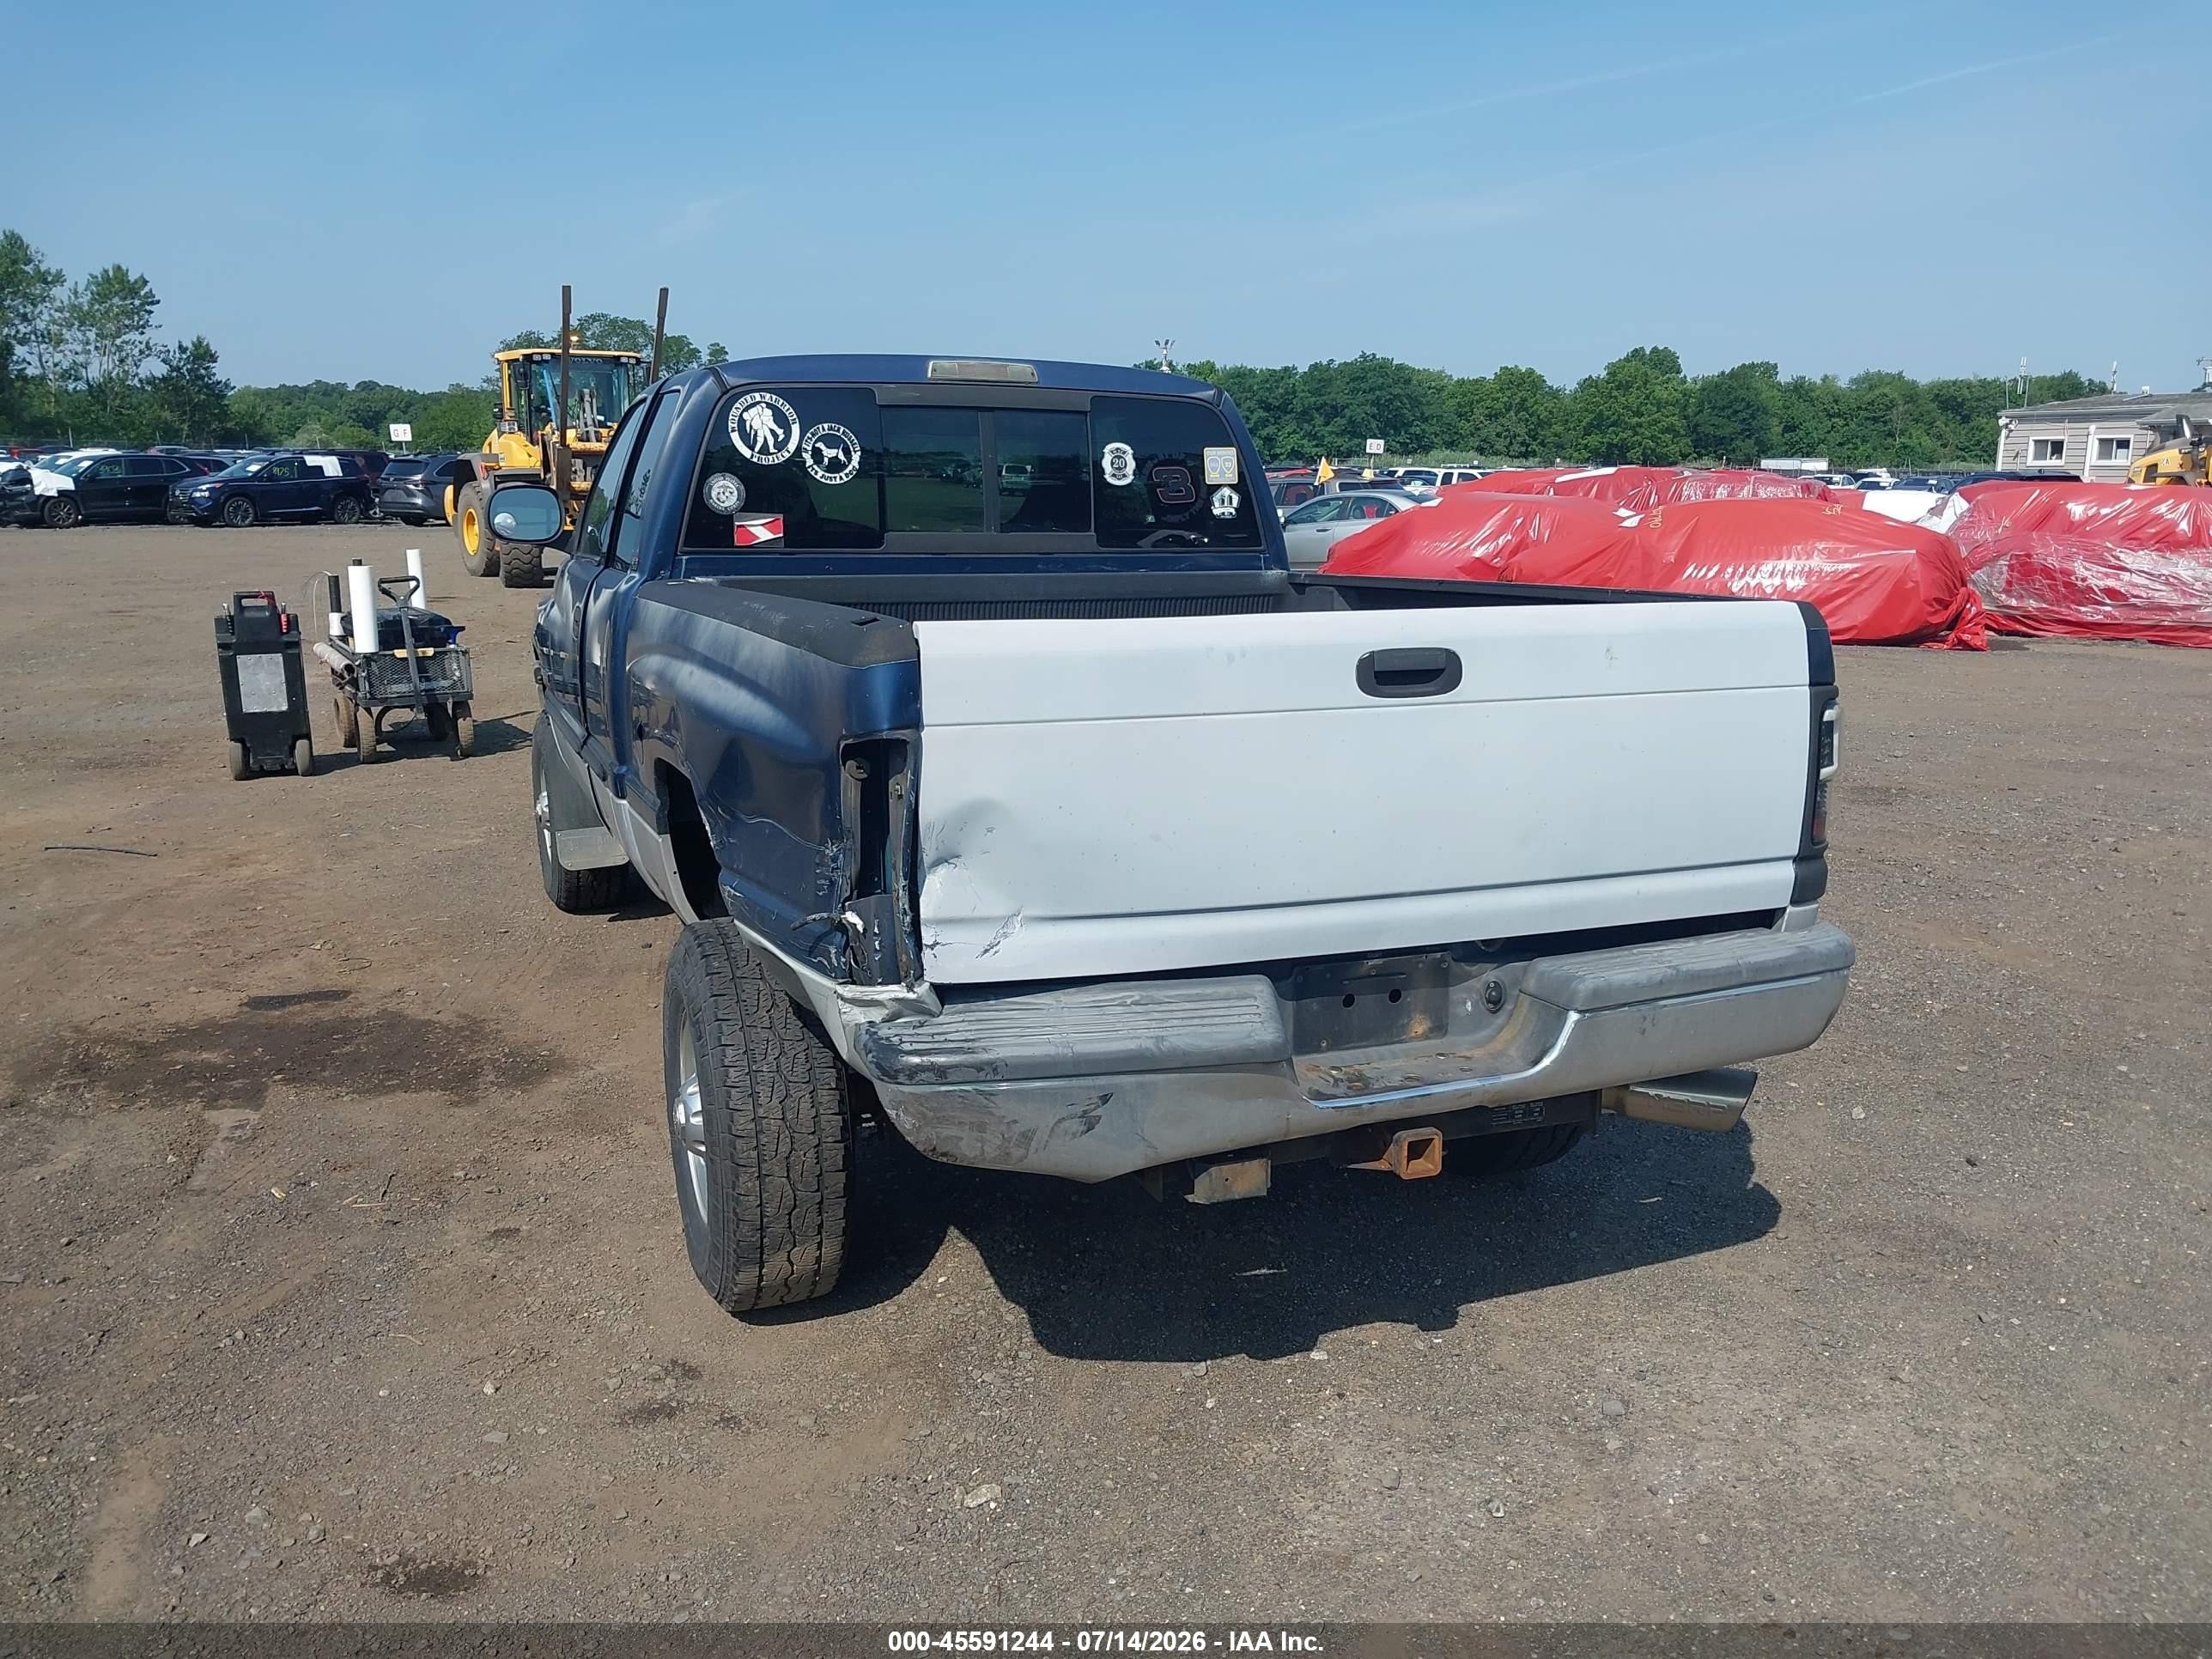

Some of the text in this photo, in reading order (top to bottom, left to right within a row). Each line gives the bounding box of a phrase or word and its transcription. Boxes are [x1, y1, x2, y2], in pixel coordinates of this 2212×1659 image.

[730, 393, 798, 434] WOUNDED WARRIOR
[828, 424, 842, 434] JACK
[842, 428, 860, 453] RUSSELL
[750, 447, 792, 464] PROJECT
[1112, 458, 1126, 468] 20
[819, 473, 838, 483] JUST
[1152, 466, 1195, 503] 3
